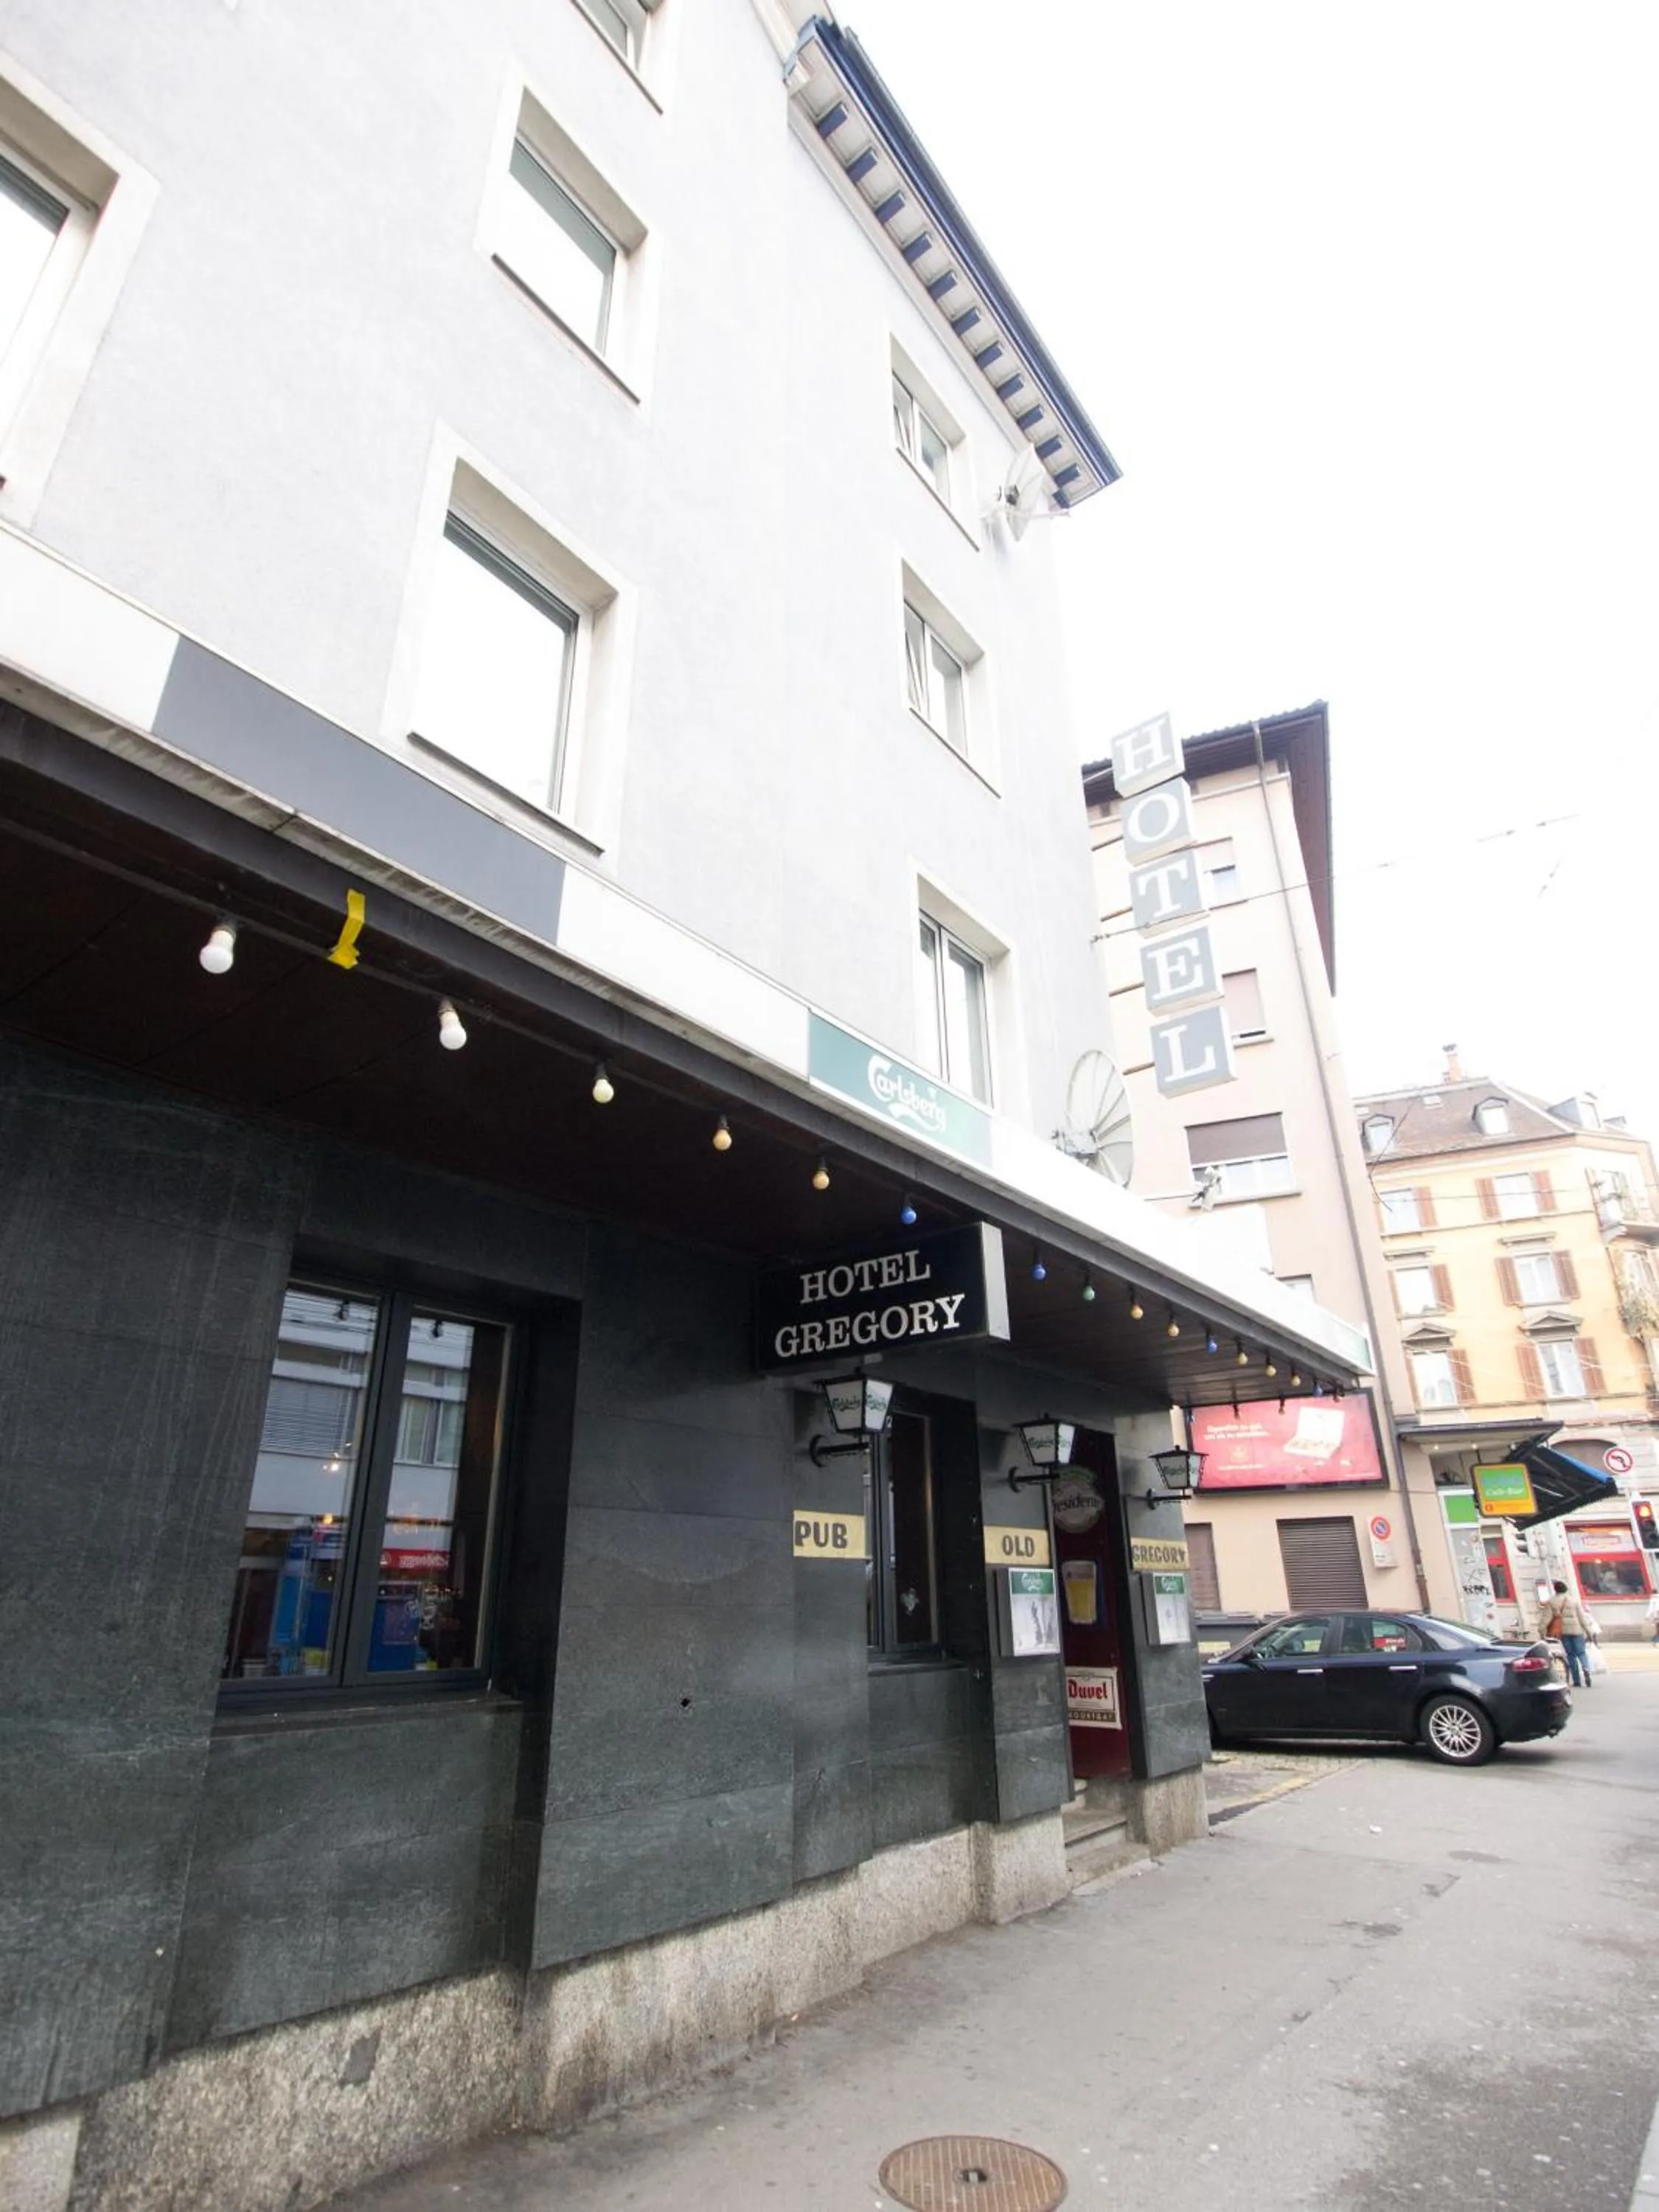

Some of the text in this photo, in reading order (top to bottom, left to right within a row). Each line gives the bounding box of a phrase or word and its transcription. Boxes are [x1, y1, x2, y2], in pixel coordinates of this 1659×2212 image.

[1115, 716, 1216, 1083] HOTEL
[868, 1054, 947, 1133] Carlsberg
[799, 1250, 931, 1304] HOTEL
[775, 1293, 965, 1358] GREGORY
[794, 1520, 847, 1549] PUB
[1002, 1534, 1035, 1558] OLD
[1132, 1544, 1186, 1564] GREGORY
[1068, 1679, 1107, 1700] Duvel
